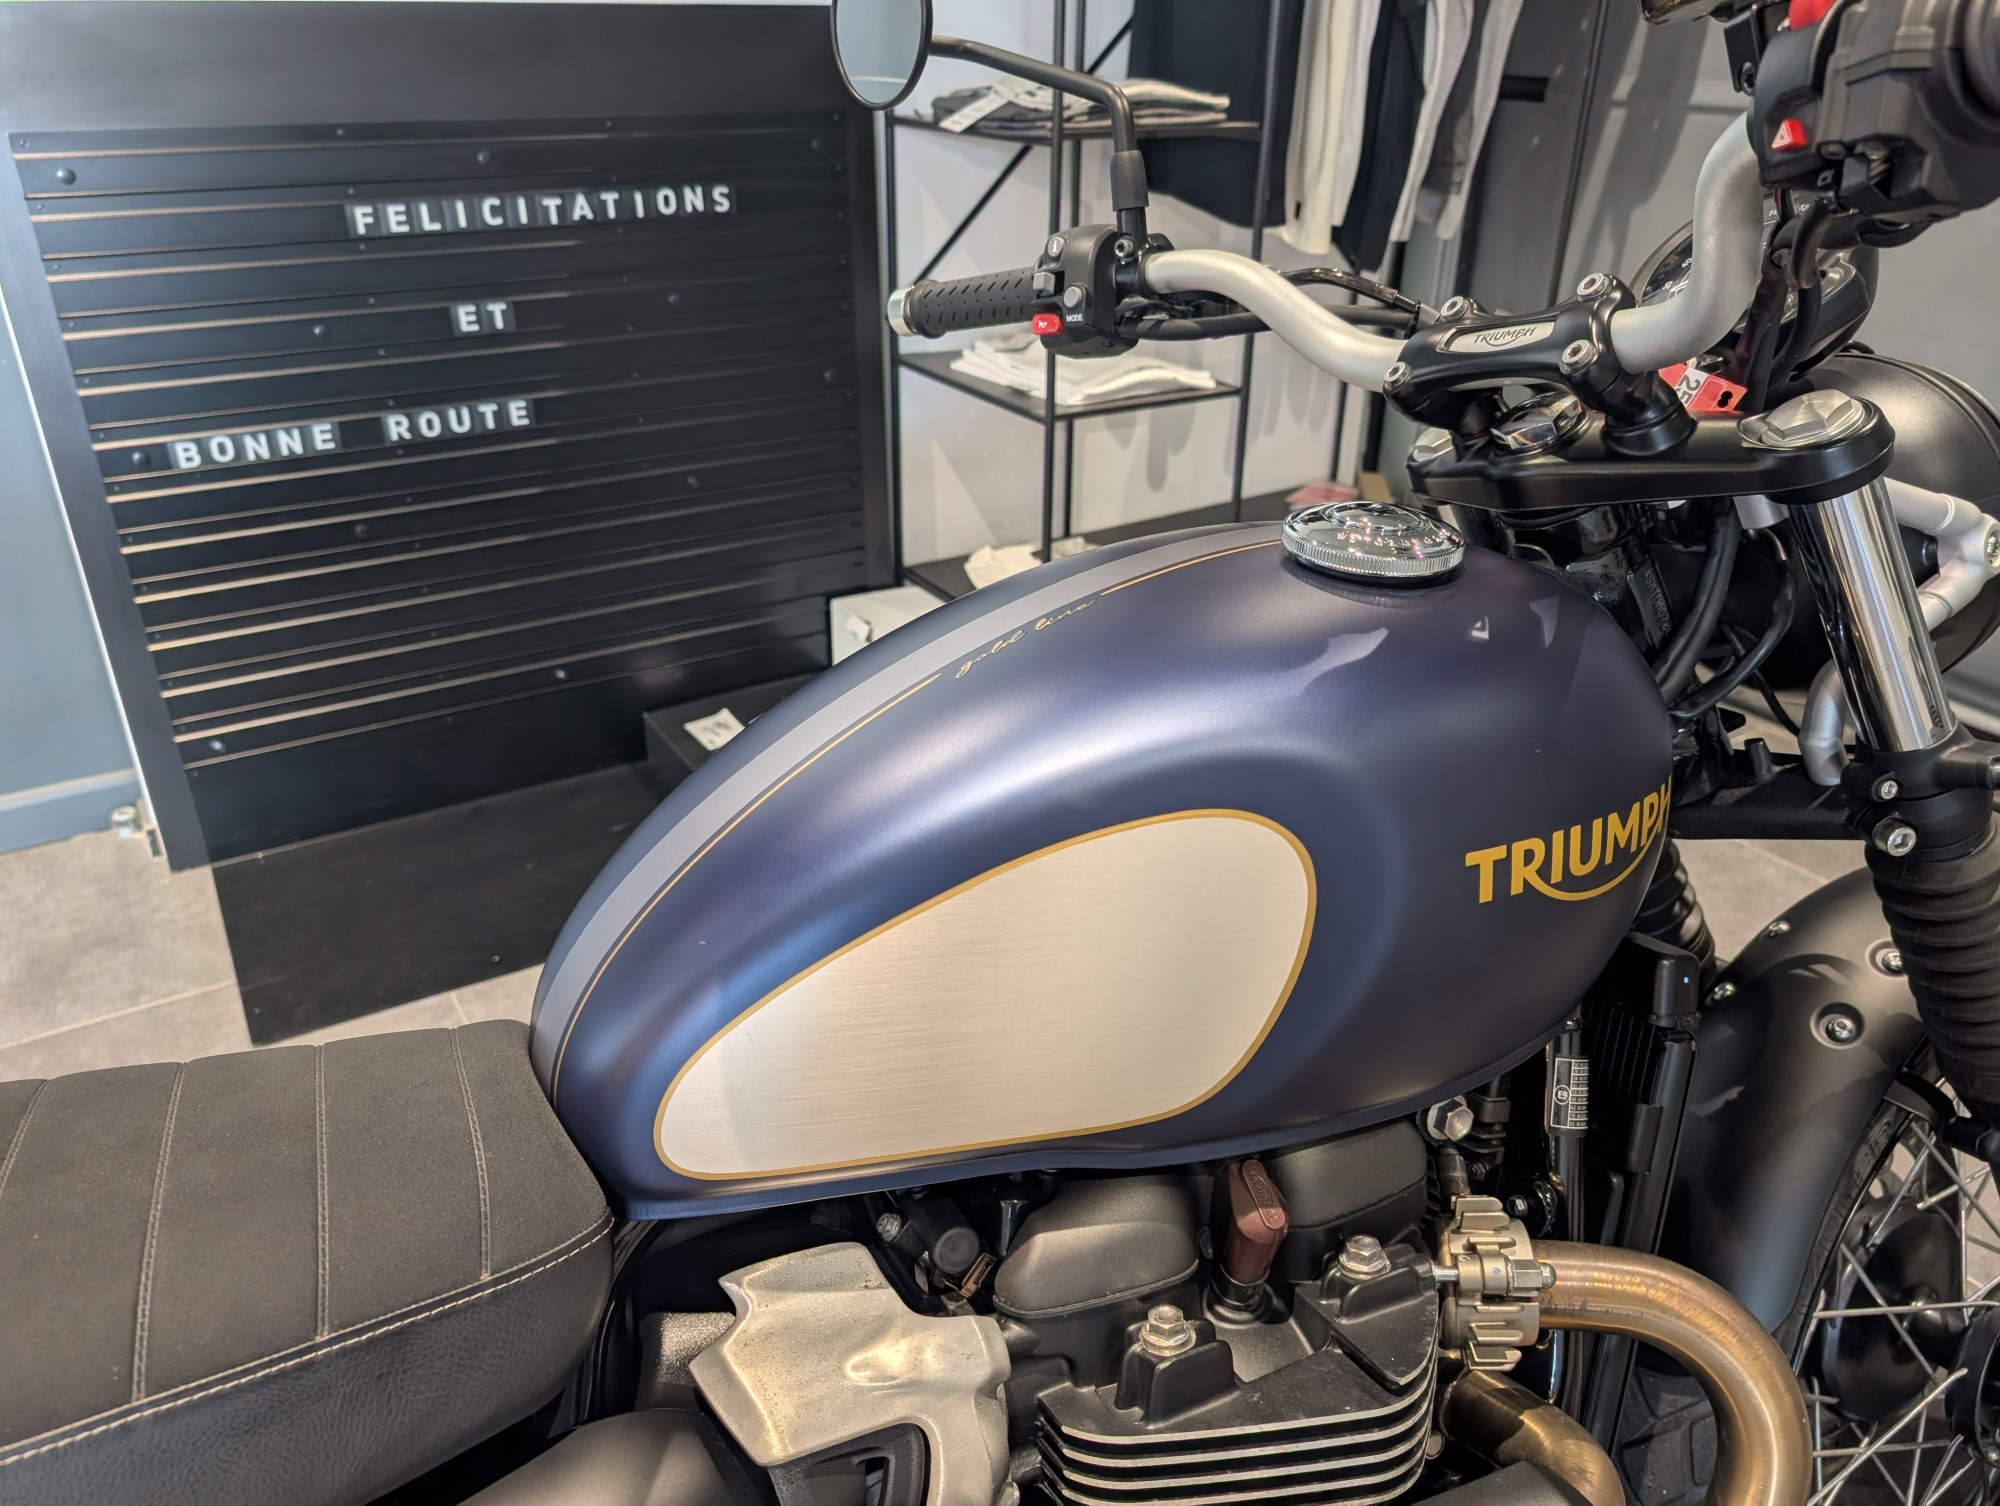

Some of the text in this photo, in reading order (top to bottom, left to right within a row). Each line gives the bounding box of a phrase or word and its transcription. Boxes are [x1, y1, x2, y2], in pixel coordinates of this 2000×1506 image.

[353, 185, 731, 235] FELICITATIONS
[457, 302, 508, 333] ET
[1066, 314, 1084, 323] MODE
[1473, 326, 1538, 347] TRIUMPH
[174, 400, 531, 470] BONNE ROUTE
[956, 629, 1028, 679] gold
[1465, 773, 1673, 904] TRIUMPH
[1557, 1090, 1568, 1100] E9
